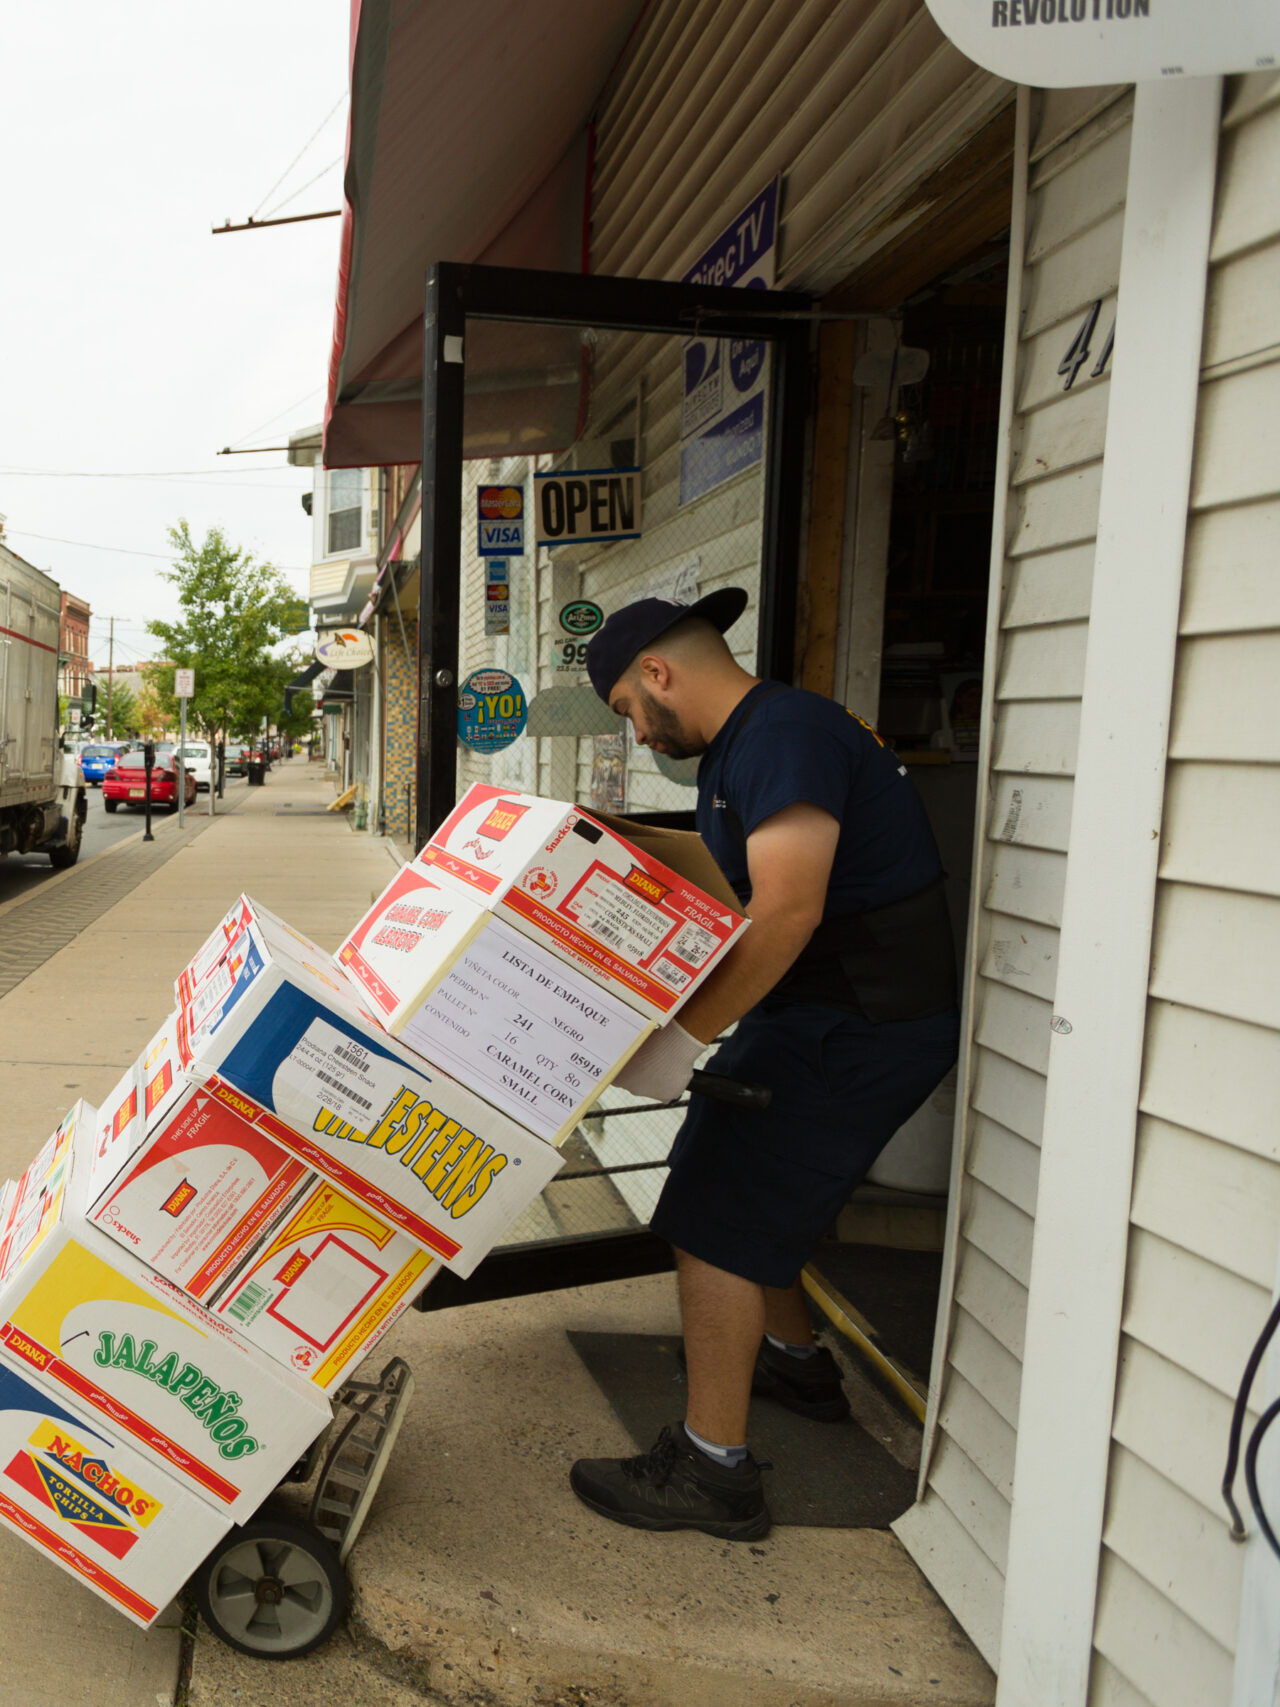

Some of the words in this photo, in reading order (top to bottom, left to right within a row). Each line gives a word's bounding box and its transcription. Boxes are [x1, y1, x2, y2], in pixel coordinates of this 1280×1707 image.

[542, 477, 634, 537] OPEN
[484, 527, 520, 543] VISA
[489, 604, 508, 613] VISA
[478, 694, 522, 724] ¡YO!
[545, 825, 571, 854] Snacks
[630, 873, 661, 898] DIANA
[614, 908, 629, 920] 245
[679, 889, 695, 902] THIS
[708, 908, 720, 919] UP
[683, 906, 716, 931] FRAGIL
[531, 908, 570, 937] PRODUCTO
[568, 933, 593, 953] HECHO
[592, 949, 604, 960] EN
[602, 956, 613, 966] EL
[612, 962, 648, 989] SALVADOR
[550, 938, 576, 958] HANDLE
[576, 955, 593, 969] WITH
[592, 966, 611, 981] CARE
[462, 955, 494, 981] VIÑETA
[491, 976, 520, 999] COLOR
[551, 1016, 585, 1042] NEGRO
[501, 950, 536, 977] LISTA
[535, 972, 554, 990] DE
[551, 984, 610, 1028] EMPAQUE
[436, 987, 467, 1011] PALLET
[503, 1030, 519, 1045] 16
[534, 1052, 558, 1073] QTY
[563, 1071, 582, 1088] 80
[448, 972, 479, 996] PEDIDO
[512, 1013, 534, 1032] 241
[570, 1052, 602, 1077] 05918
[344, 1040, 369, 1060] 1561
[423, 1003, 470, 1038] CONTENIDO
[485, 1043, 543, 1087] CARAMEL
[543, 1083, 576, 1108] CORN
[322, 1061, 336, 1073] (125
[357, 1073, 376, 1088] Snack
[217, 1087, 256, 1118] DIANA
[498, 1074, 540, 1106] SMALL
[187, 1113, 211, 1139] FRAGIL
[313, 1084, 508, 1219] ESTEENS
[169, 1187, 191, 1211] DIANA
[113, 1221, 141, 1245] Snacks
[204, 1244, 233, 1276] PRODUCTO
[230, 1224, 250, 1246] HECHO
[246, 1215, 257, 1226] EN
[253, 1207, 263, 1217] EL
[259, 1179, 287, 1210] SALVADOR
[221, 1259, 237, 1279] STORE
[259, 1219, 272, 1235] AND
[269, 1207, 280, 1222] DRY
[278, 1194, 294, 1211] AREA
[282, 1256, 306, 1283] DIANA
[332, 1334, 360, 1366] PRODUCTO
[357, 1314, 377, 1336] HECHO
[374, 1306, 384, 1316] EN
[380, 1298, 390, 1308] EL
[387, 1270, 414, 1300] SALVADOR
[362, 1329, 382, 1351] HANDLE
[380, 1316, 393, 1330] WITH
[391, 1301, 405, 1317] CARE
[10, 1334, 45, 1366] DIANA
[94, 1331, 259, 1460] JALAPEÑOS
[47, 1435, 150, 1517] NACHOS
[48, 1476, 104, 1521] TORTILLA
[53, 1492, 89, 1520] CHIPS
